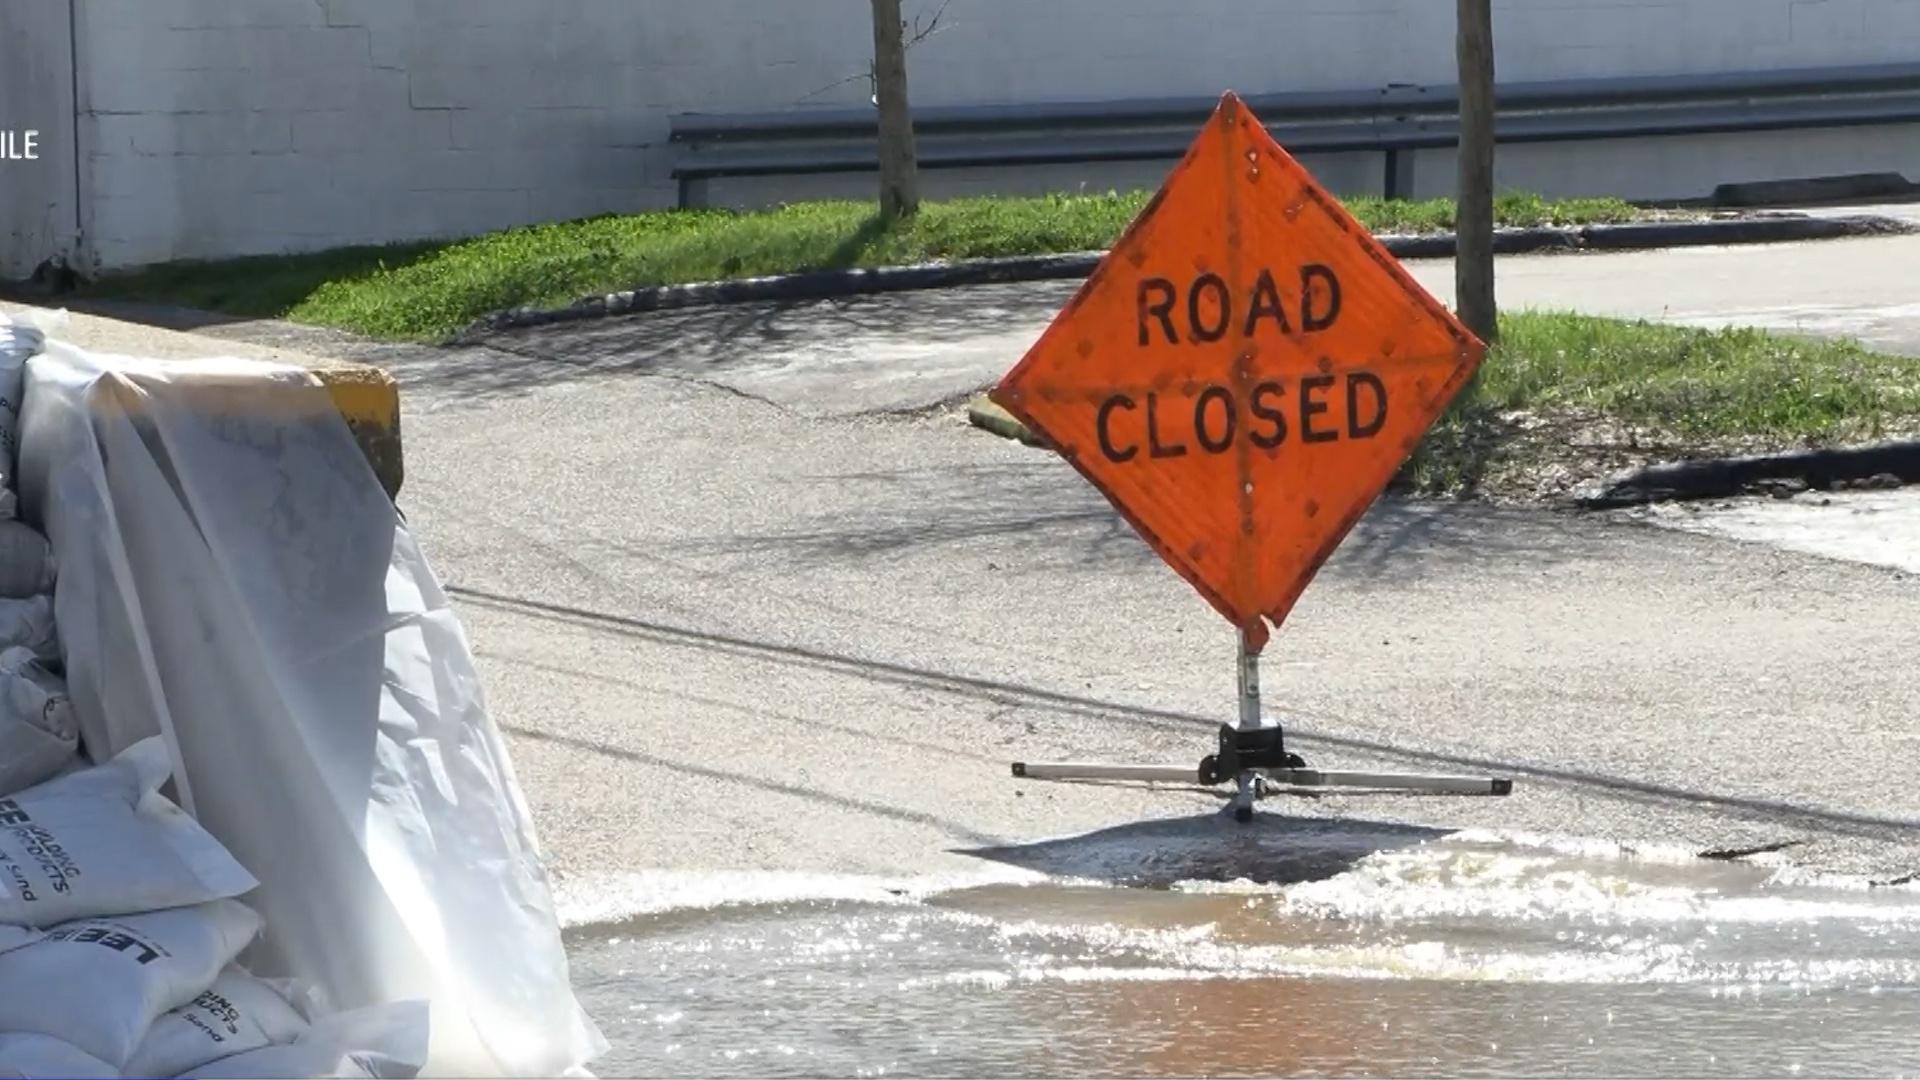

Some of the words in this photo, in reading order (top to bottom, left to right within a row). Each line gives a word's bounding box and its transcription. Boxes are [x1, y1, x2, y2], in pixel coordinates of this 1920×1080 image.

[1138, 264, 1340, 345] ROAD
[1096, 371, 1389, 463] CLOSED
[76, 928, 160, 965] LEE
